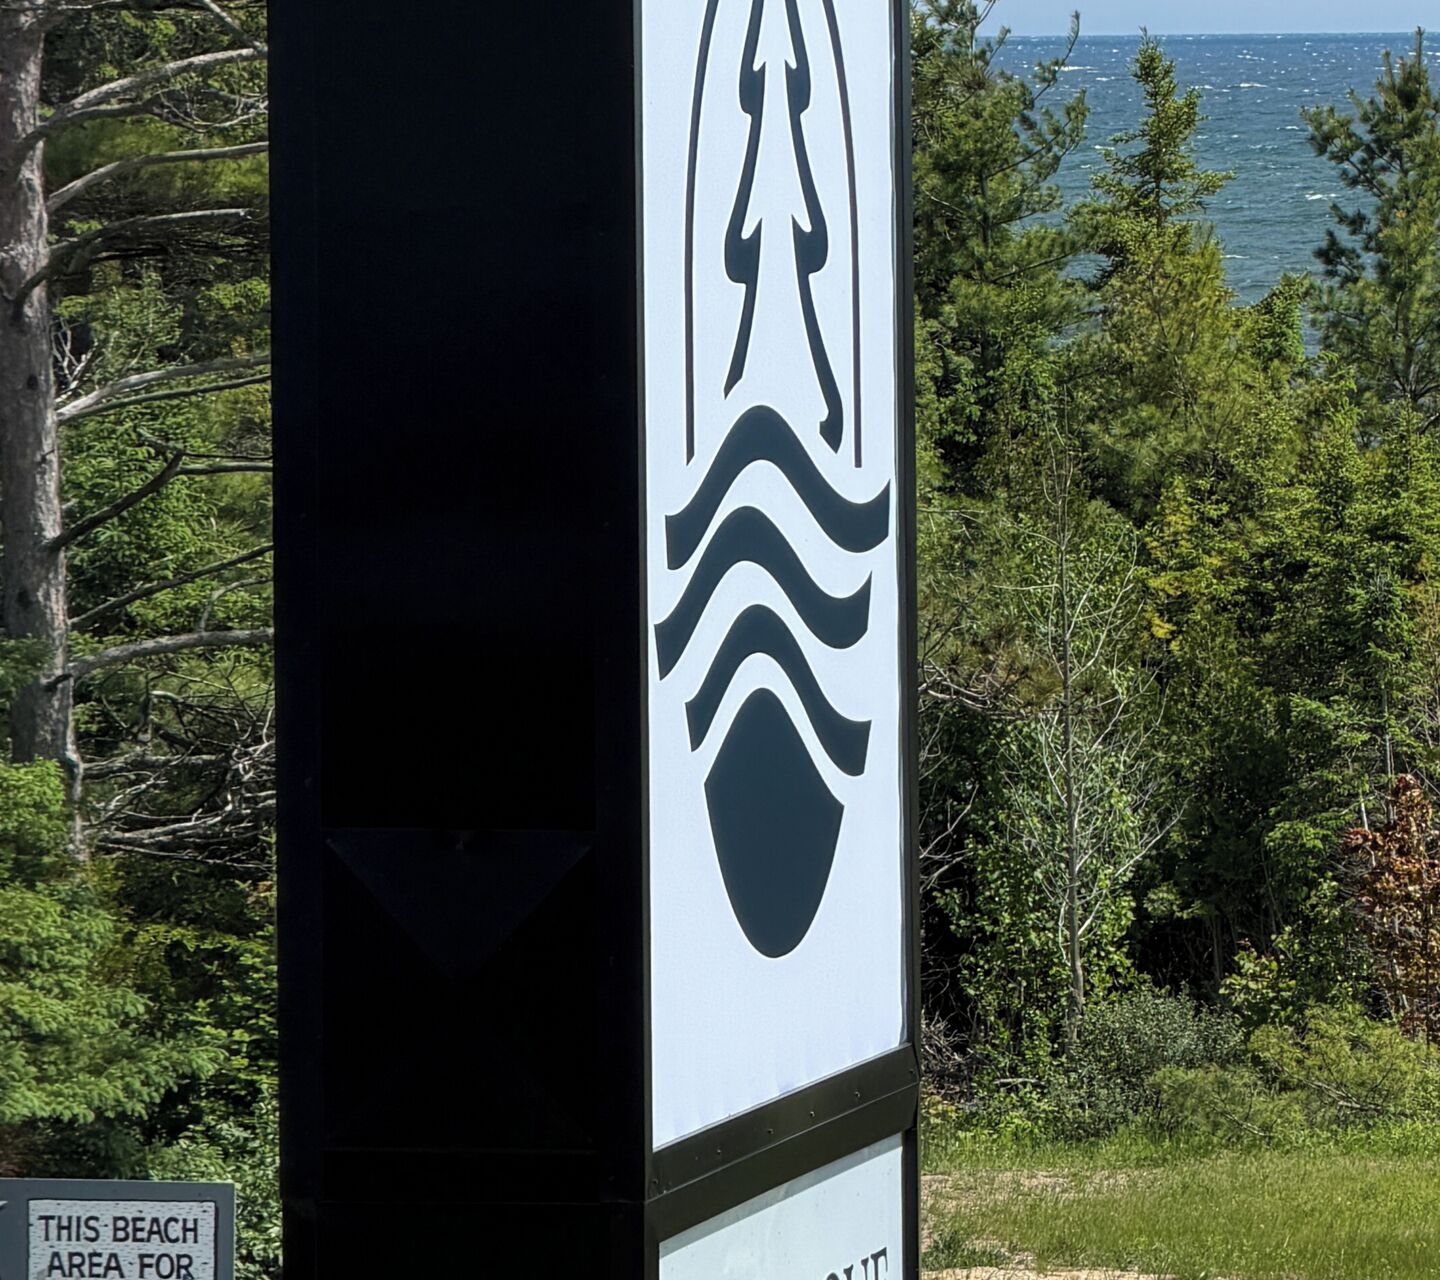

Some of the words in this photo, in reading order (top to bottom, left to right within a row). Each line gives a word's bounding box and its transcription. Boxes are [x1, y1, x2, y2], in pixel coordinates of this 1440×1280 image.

[38, 1215, 100, 1242] THIS
[112, 1216, 198, 1243] BEACH
[47, 1252, 125, 1278] AREA
